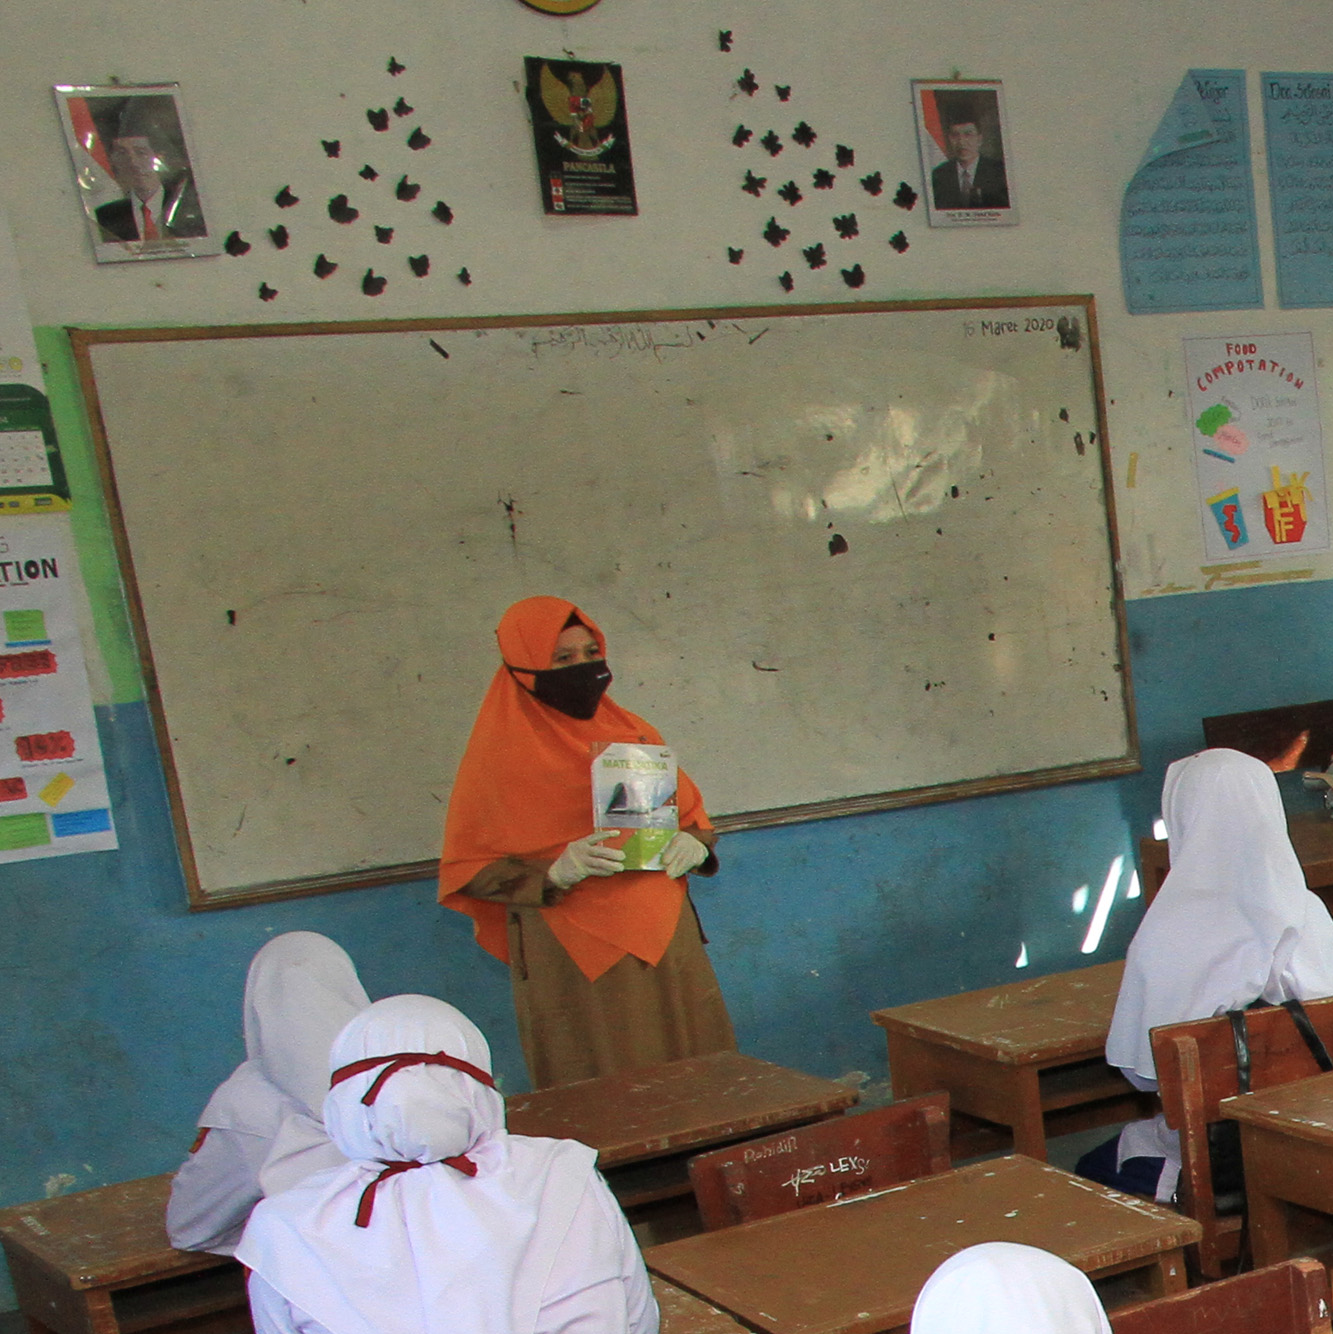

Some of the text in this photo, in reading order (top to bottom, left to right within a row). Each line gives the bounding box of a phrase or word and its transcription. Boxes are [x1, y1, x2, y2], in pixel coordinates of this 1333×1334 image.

[981, 320, 1018, 336] Maret
[1024, 317, 1055, 333] 2020
[1225, 343, 1257, 357] FOOD
